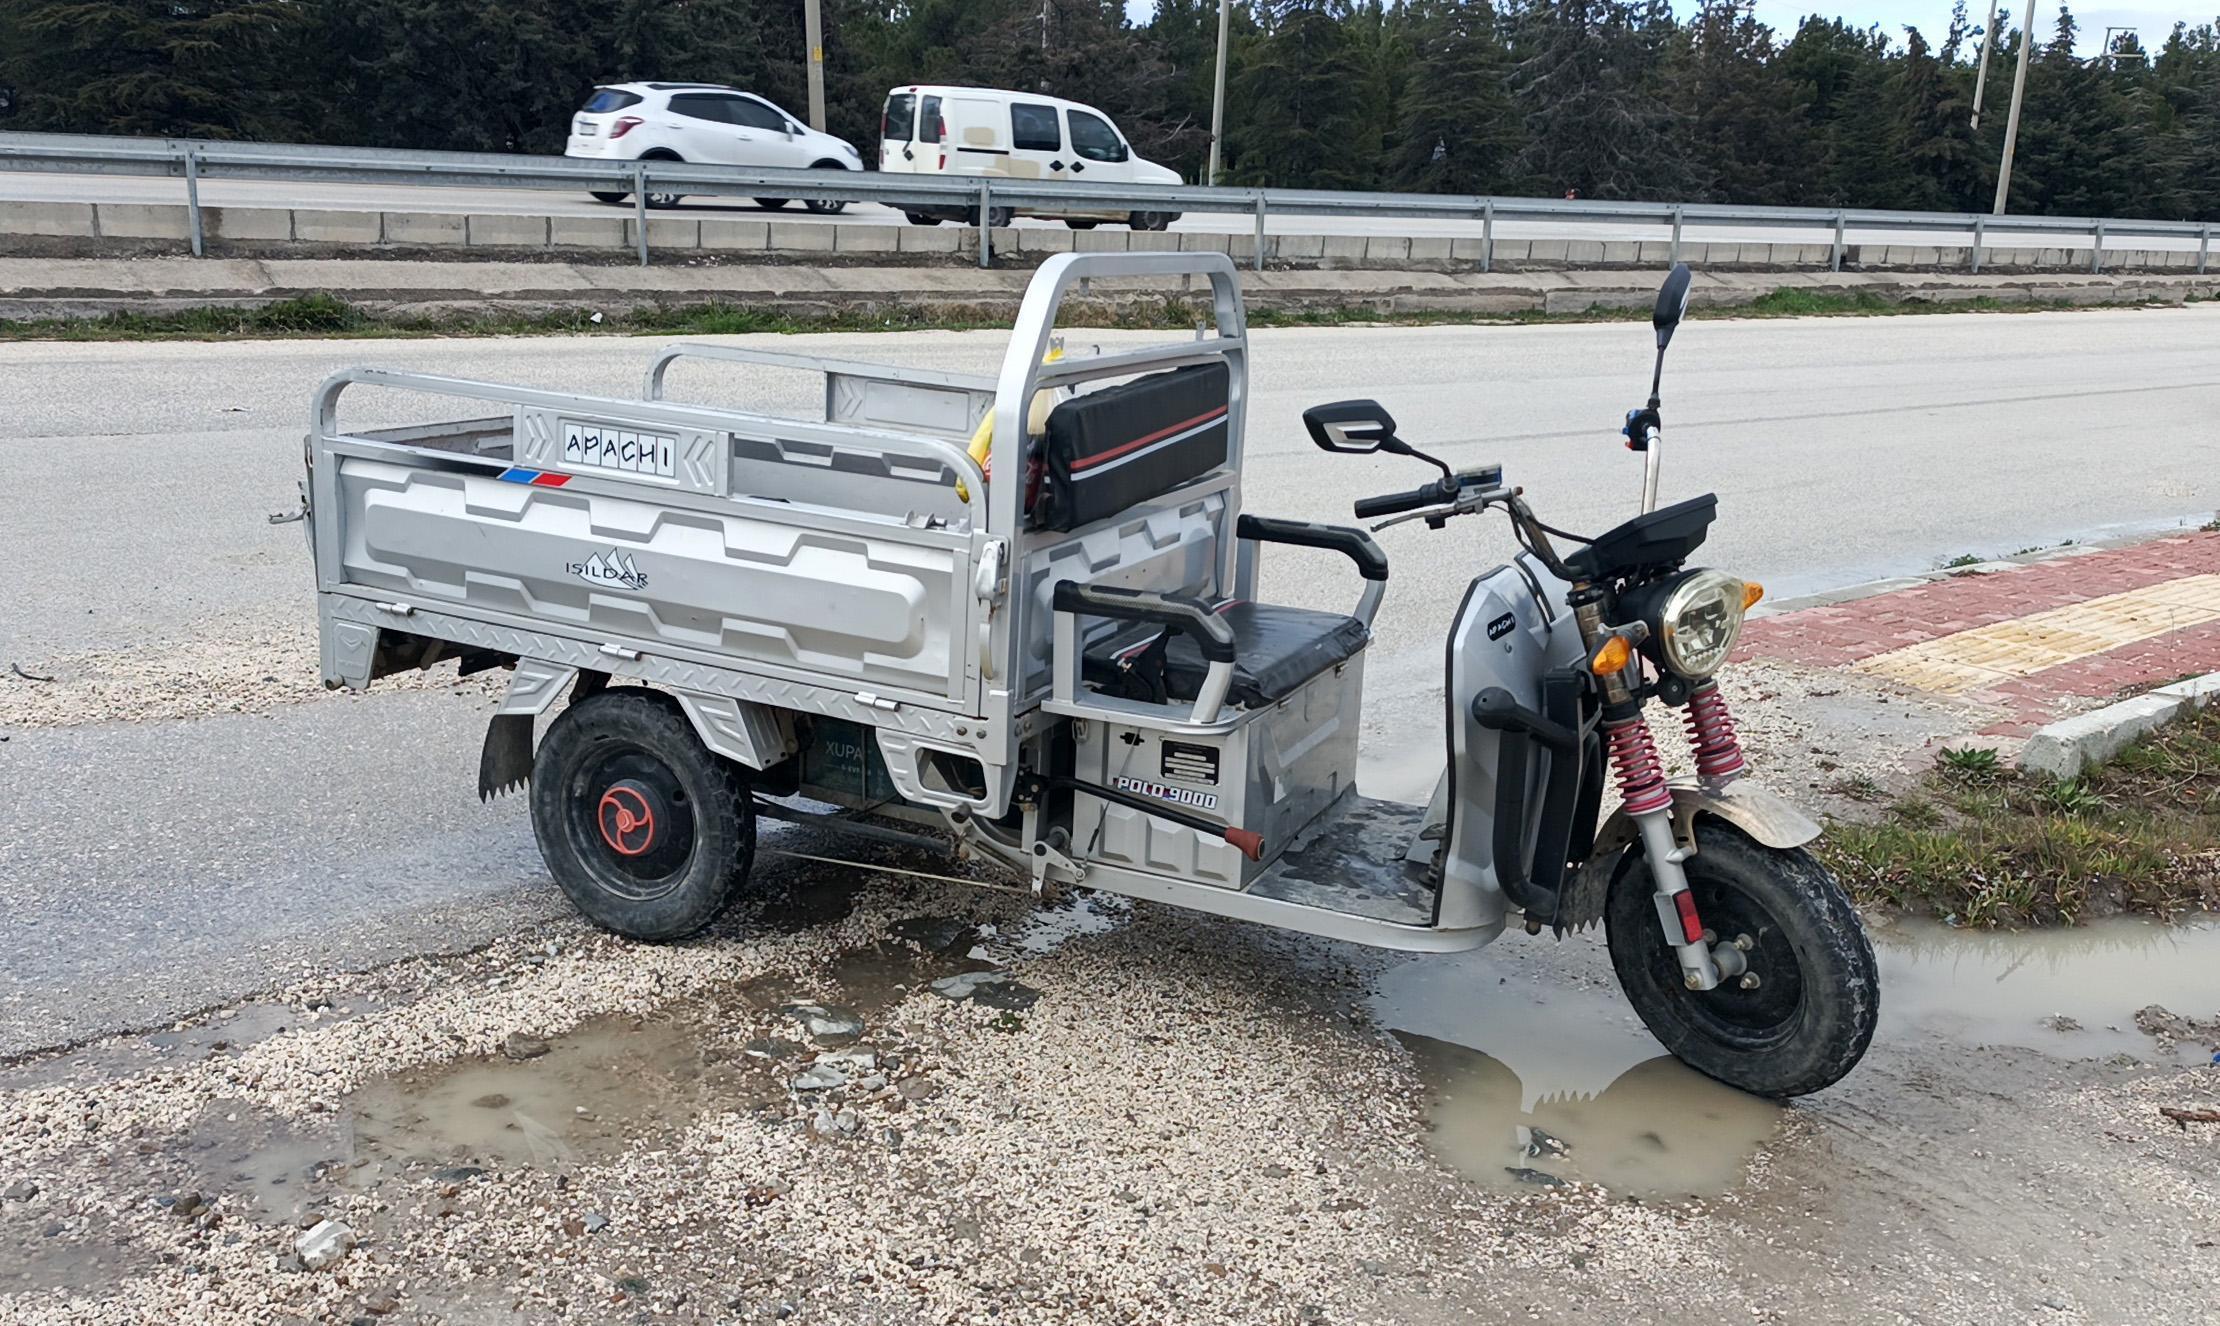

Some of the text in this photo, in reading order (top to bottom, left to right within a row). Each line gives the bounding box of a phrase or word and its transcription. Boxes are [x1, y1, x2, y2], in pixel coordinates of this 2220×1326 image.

[566, 433, 669, 467] APACHI
[565, 562, 649, 585] ISILDAR
[1117, 776, 1218, 809] POLO 9000
